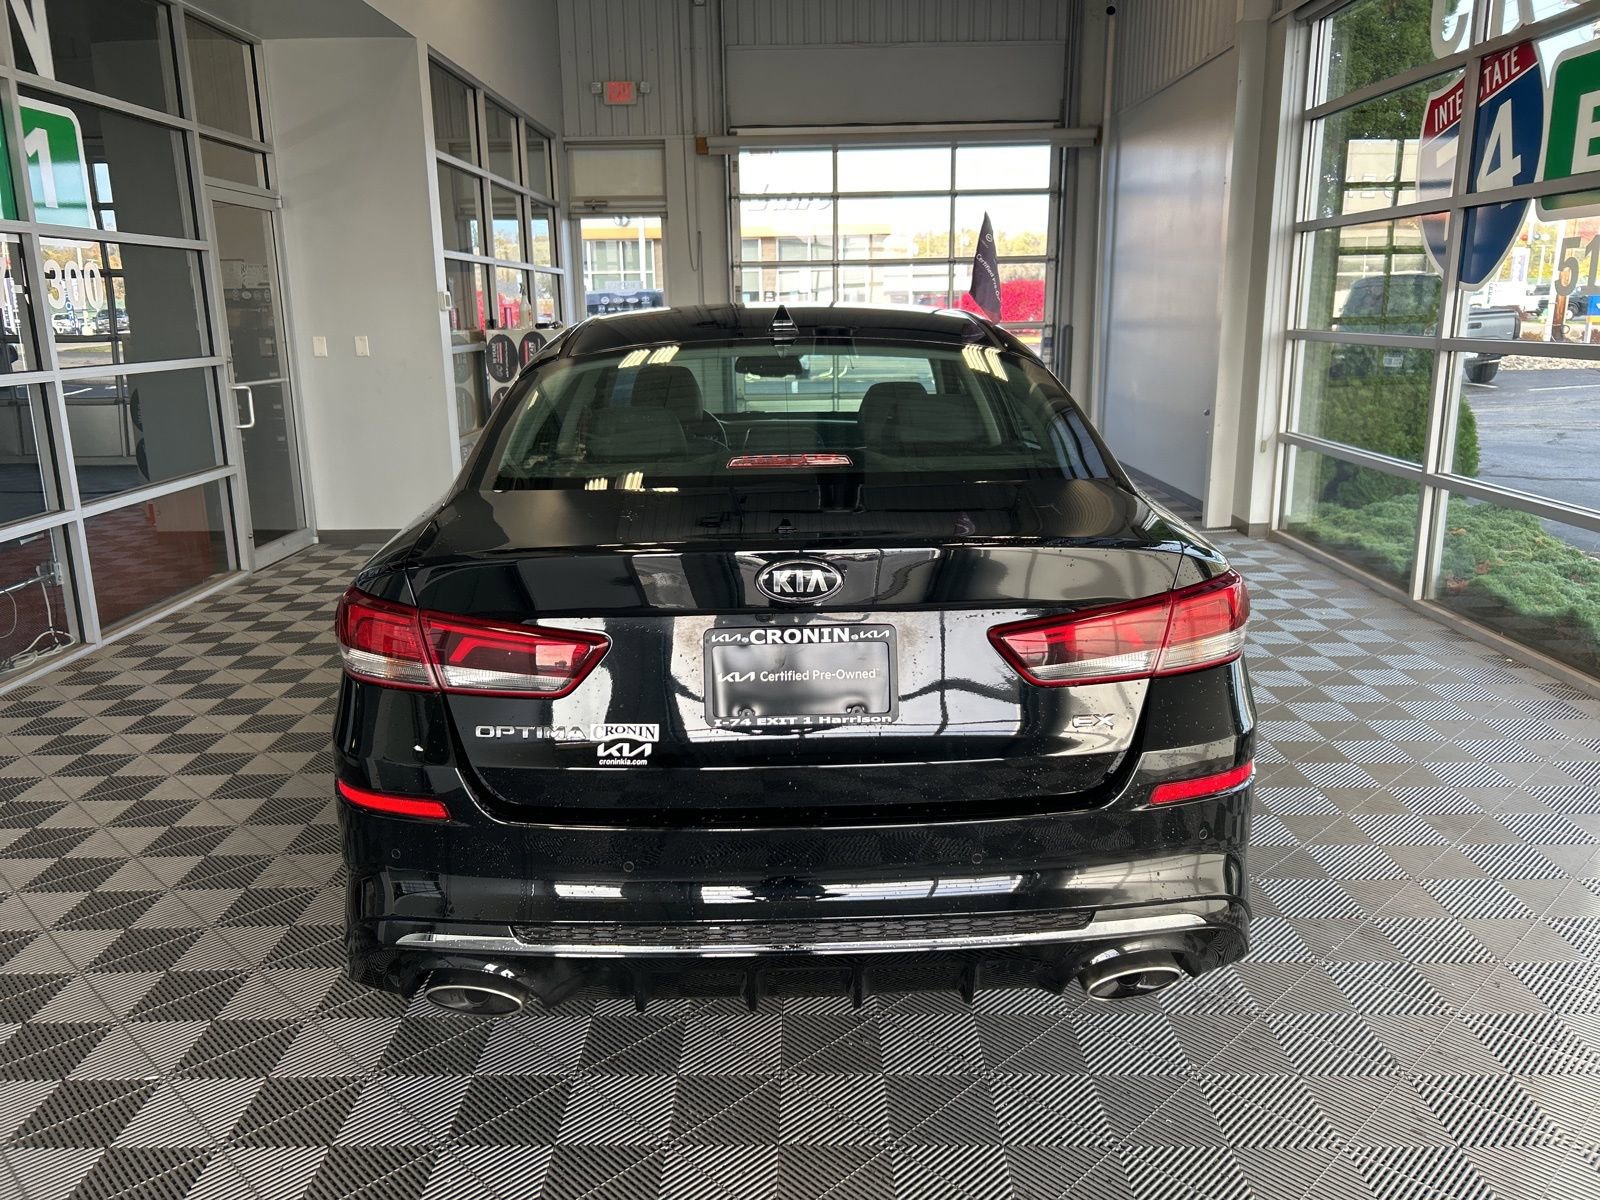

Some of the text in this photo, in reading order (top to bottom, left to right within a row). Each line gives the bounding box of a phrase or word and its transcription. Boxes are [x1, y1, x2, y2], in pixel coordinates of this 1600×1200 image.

[1434, 46, 1520, 132] INTETATE
[24, 127, 58, 208] 1
[772, 569, 829, 593] KIA
[711, 628, 890, 645] KIA CRONIN KIA
[718, 671, 756, 683] KIA
[760, 669, 809, 682] Certified
[714, 715, 892, 727] I-74 EXIT 1 Harrison
[1072, 713, 1115, 729] EX
[475, 725, 586, 740] OPTIMA
[592, 725, 656, 739] CRONIN
[596, 742, 652, 758] KIA
[598, 758, 648, 767] croninkia.com
